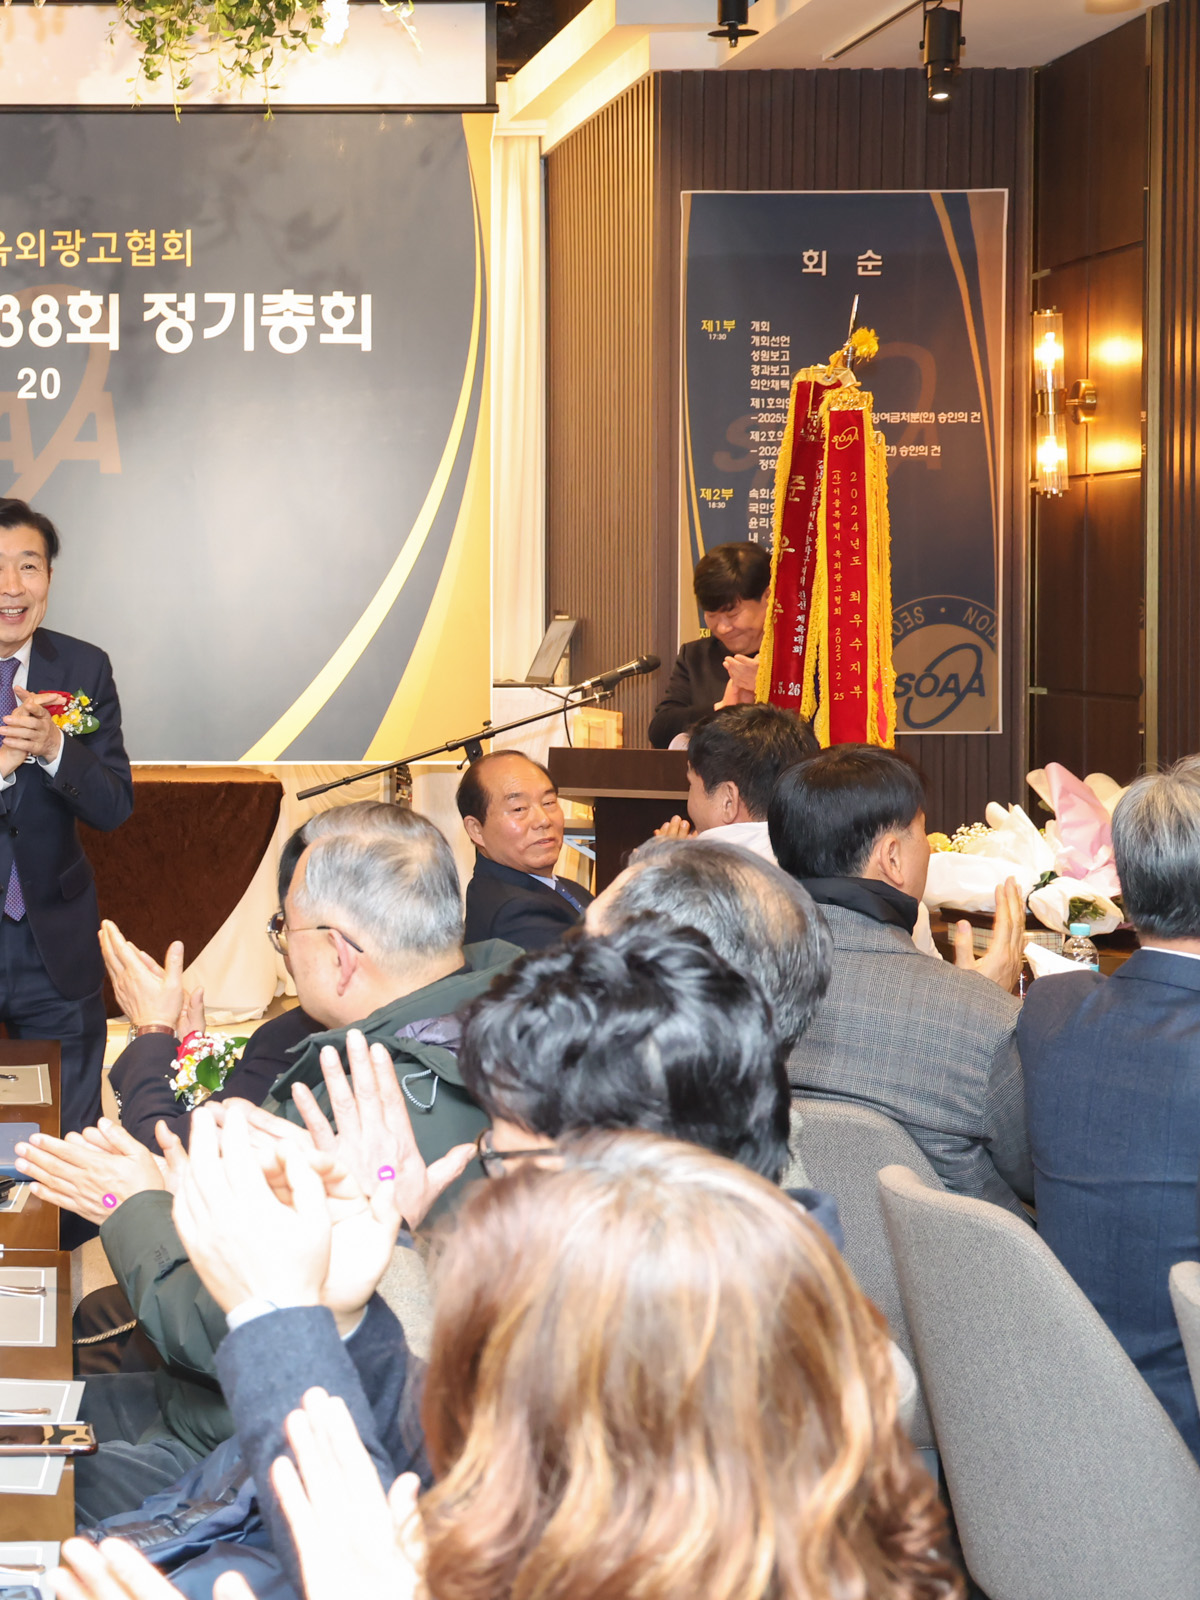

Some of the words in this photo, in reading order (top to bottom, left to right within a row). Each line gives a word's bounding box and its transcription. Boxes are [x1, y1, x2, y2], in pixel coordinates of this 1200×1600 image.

[143, 288, 373, 354] 정기총회
[701, 319, 736, 333] 제1부
[750, 320, 770, 332] 개회
[750, 335, 791, 348] 개회선언
[750, 350, 791, 362] 성원보고
[750, 364, 791, 376] 경과보고
[16, 366, 62, 400] 20
[750, 379, 791, 391] 의안채택
[937, 411, 968, 424] 승인의
[970, 411, 982, 423] 건
[899, 445, 929, 457] 승인의
[931, 445, 942, 456] 건
[699, 488, 734, 500] 제2부
[849, 471, 862, 566] 2024년도
[848, 590, 863, 700] 최우수지부
